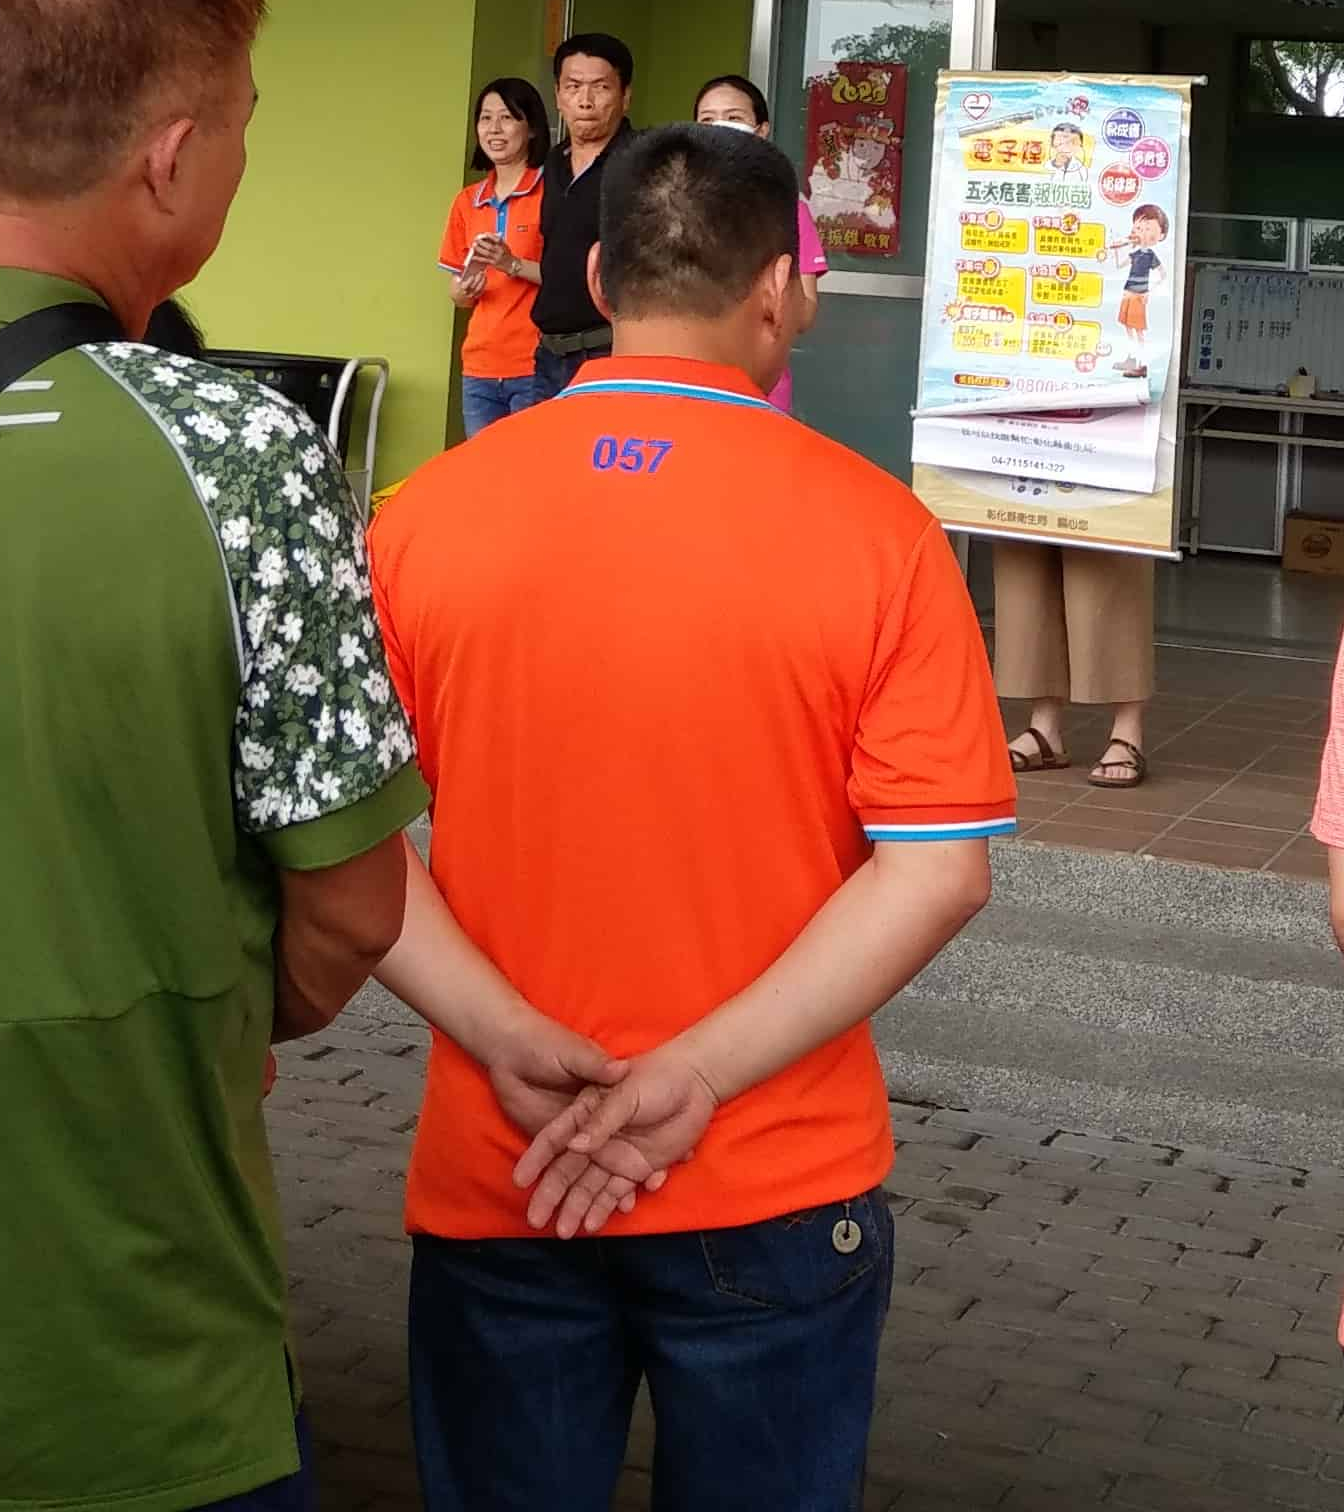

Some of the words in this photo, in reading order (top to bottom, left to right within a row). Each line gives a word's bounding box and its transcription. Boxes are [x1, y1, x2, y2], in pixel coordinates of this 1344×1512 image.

[972, 138, 1044, 165] 電子煙
[592, 434, 674, 474] 057
